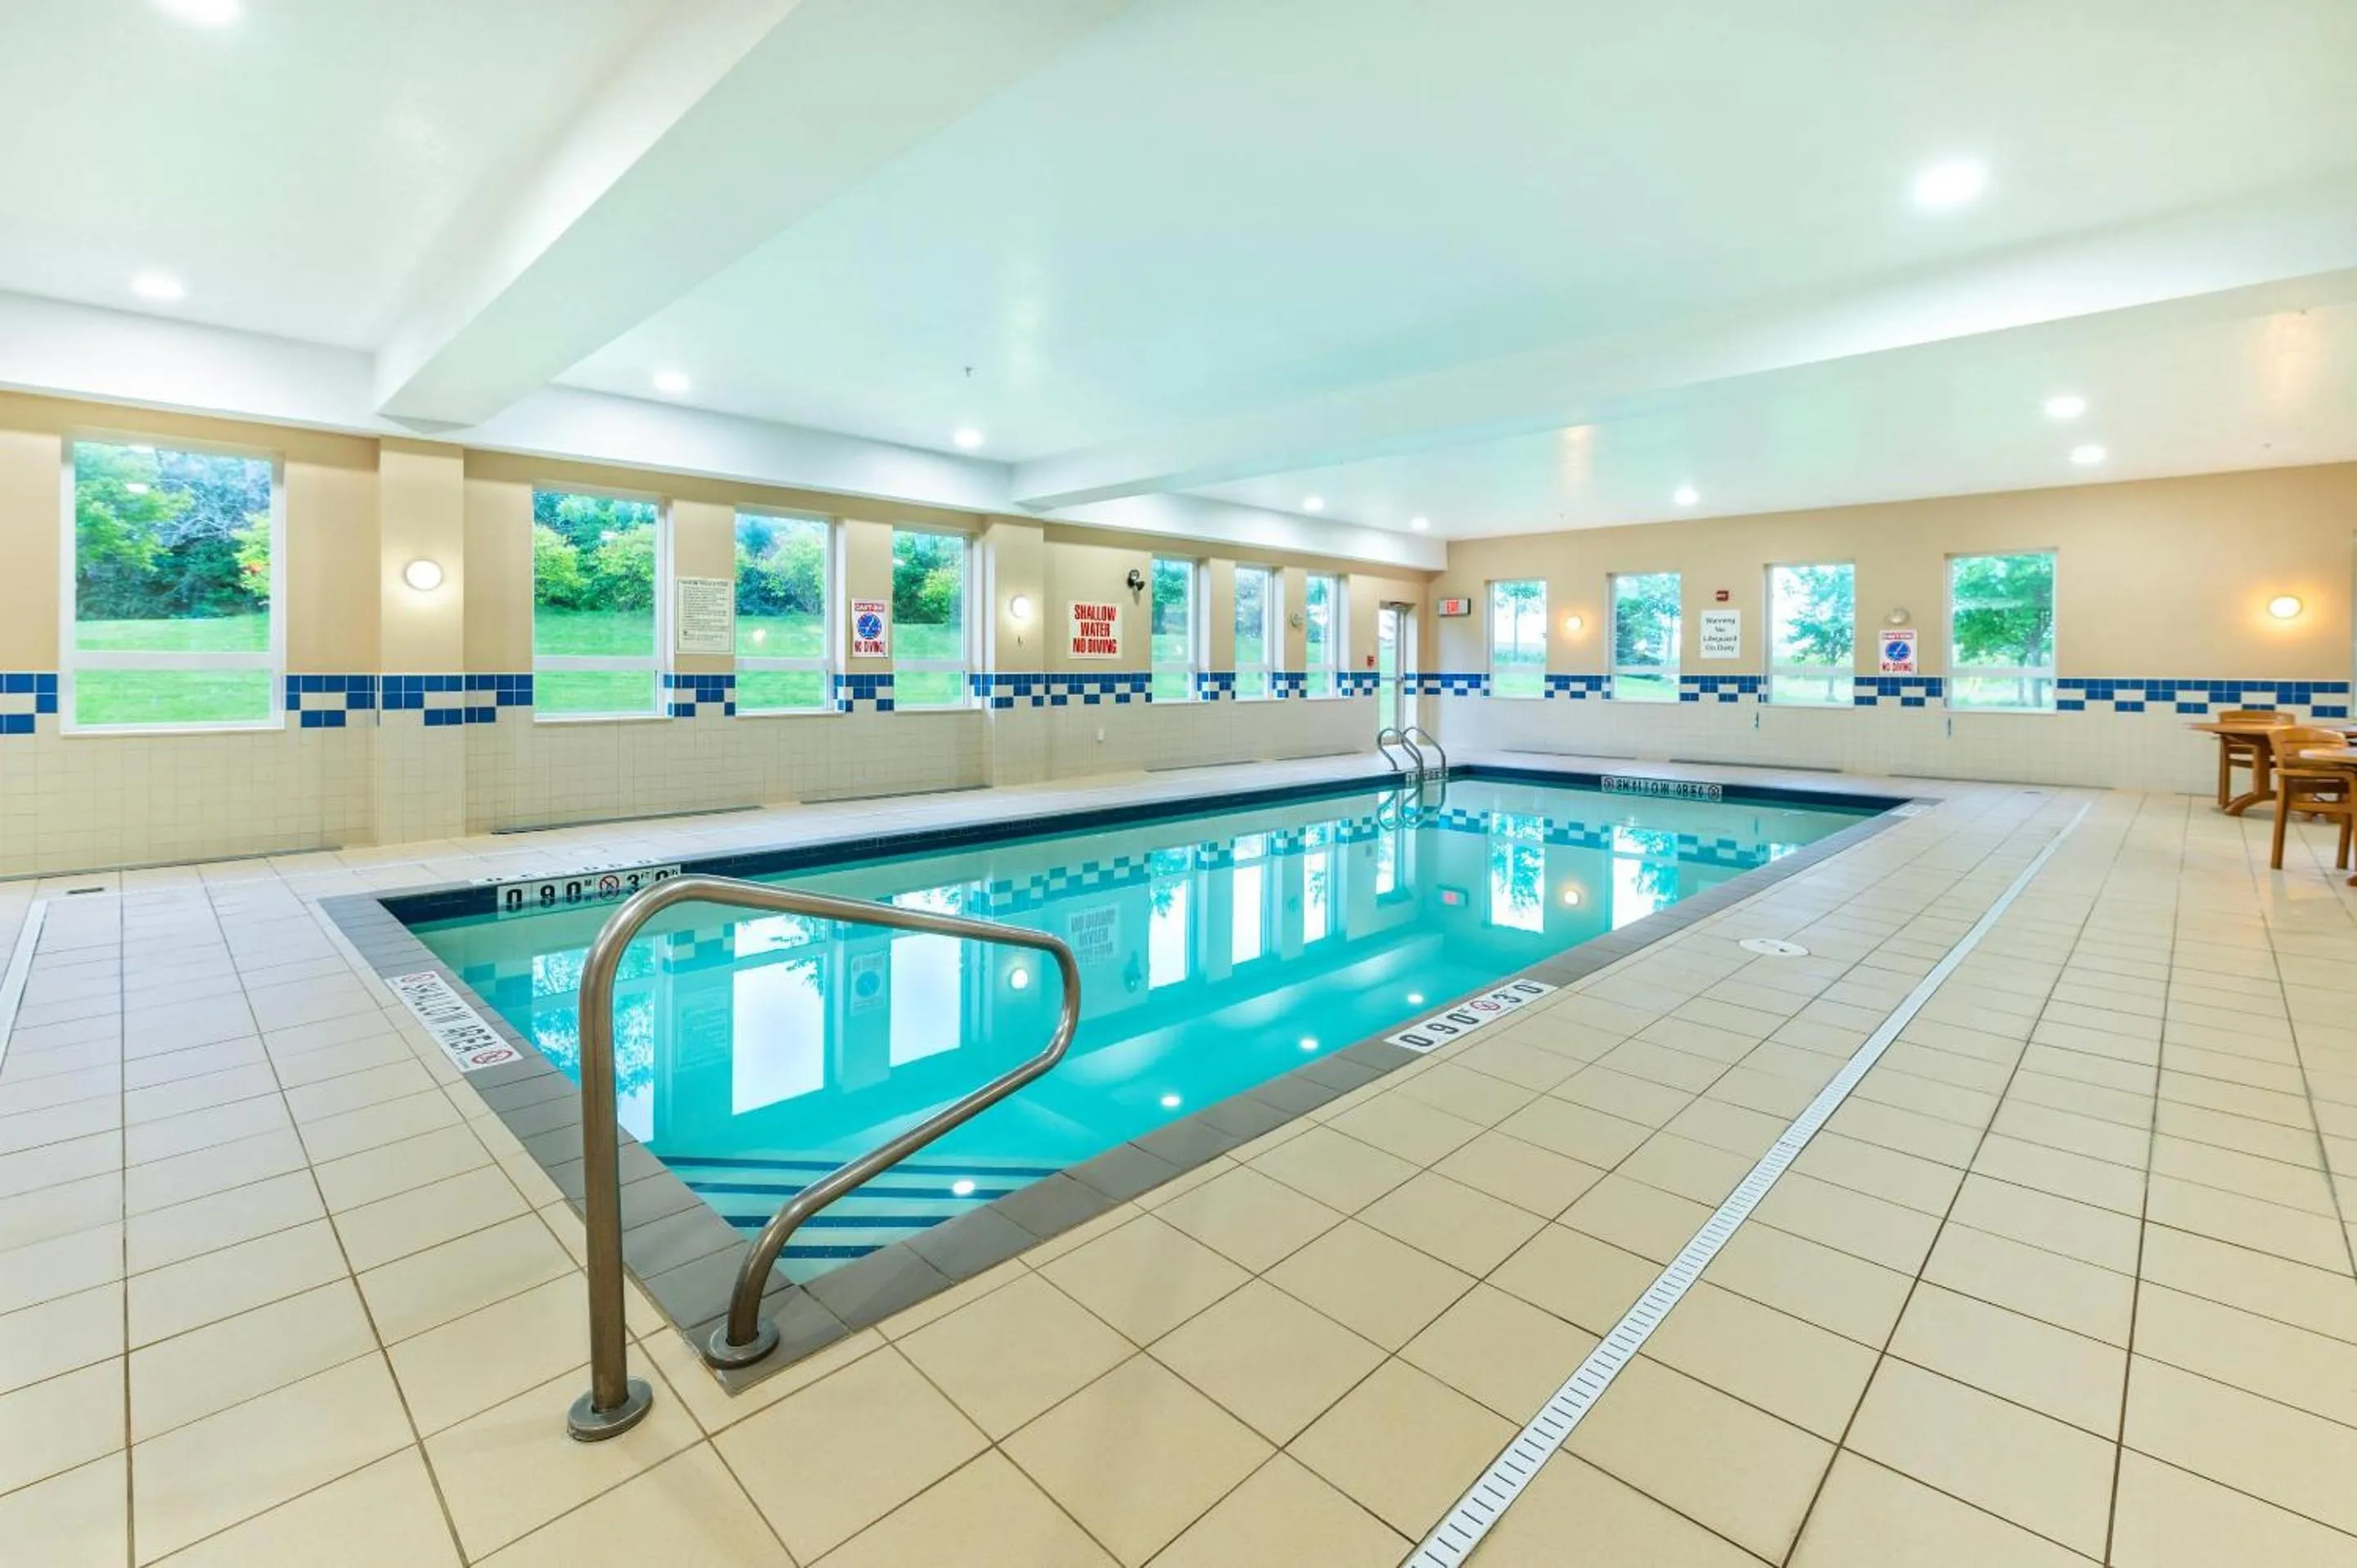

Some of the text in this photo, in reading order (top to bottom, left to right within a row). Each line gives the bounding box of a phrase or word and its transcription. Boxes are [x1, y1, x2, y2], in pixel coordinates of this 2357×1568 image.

[1074, 604, 1117, 621] SHALLOW
[1080, 621, 1111, 637] WATER
[1073, 638, 1117, 654] NO DIVING
[439, 1024, 498, 1055] AREA
